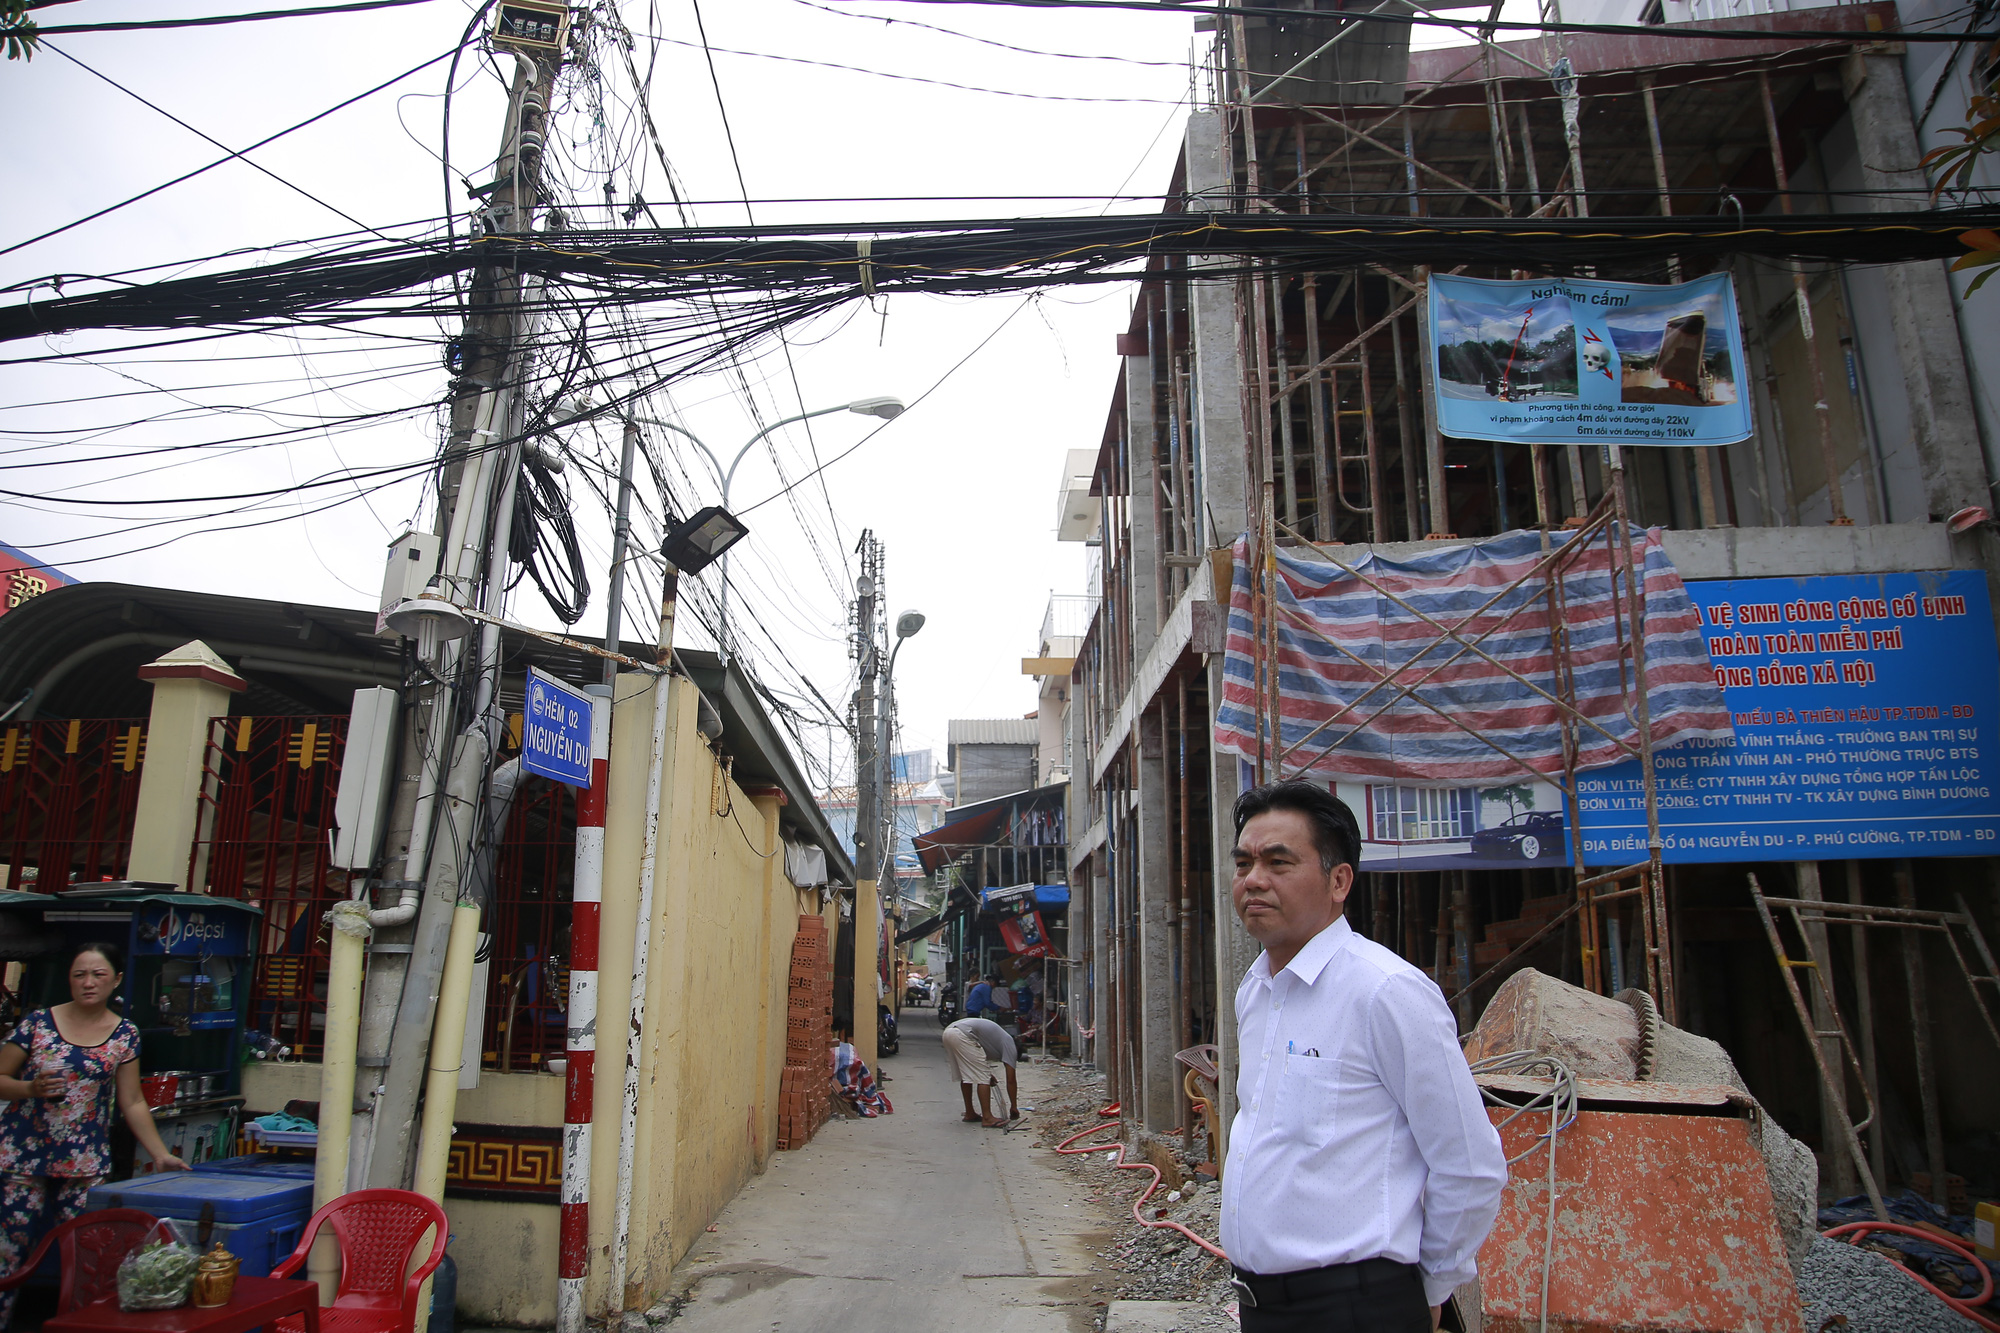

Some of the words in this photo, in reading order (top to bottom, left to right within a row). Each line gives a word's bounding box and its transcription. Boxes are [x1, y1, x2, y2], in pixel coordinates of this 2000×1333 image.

[1531, 286, 1586, 303] Nghiêm
[1591, 290, 1630, 307] cấm!
[1500, 416, 1522, 424] phạm
[1523, 415, 1554, 423] khoảng
[1577, 413, 1592, 422] 4m
[1595, 414, 1607, 423] đối
[1609, 415, 1621, 423] với
[1624, 415, 1650, 425] đường
[1651, 416, 1665, 426] dây
[1667, 415, 1690, 425] 22kV
[1529, 404, 1562, 412] Phương
[1564, 404, 1579, 412] tiện
[1593, 404, 1615, 413] công,
[1640, 405, 1655, 413] giới
[1577, 426, 1593, 435] 6m
[1595, 426, 1608, 435] đối
[1609, 427, 1622, 436] với
[1624, 428, 1650, 437] đường
[1651, 428, 1665, 438] dây
[1667, 428, 1695, 437] 110kV
[1708, 601, 1734, 630] VỆ
[1738, 603, 1781, 625] SINH
[1785, 598, 1834, 623] CÔNG
[1837, 596, 1889, 624] CỘNG
[1891, 591, 1917, 618] CỐ
[1922, 595, 1966, 621] ĐỊNH
[1709, 631, 1761, 657] HOÀN
[1764, 629, 1816, 654] TOÀN
[1818, 624, 1869, 653] MIỄN
[1872, 625, 1903, 651] PHÍ
[1714, 664, 1753, 692] ỘNG
[1757, 659, 1808, 687] ĐỒNG
[1812, 659, 1838, 685] XÃ
[1842, 659, 1876, 688] HỘI
[544, 694, 566, 724] HẺM
[568, 709, 579, 730] 02
[1735, 706, 1773, 726] MIẾU
[1776, 707, 1798, 724] BÀ
[1799, 707, 1846, 724] THIÊN
[1848, 705, 1881, 725] HẬU
[1883, 706, 1939, 721] TP.TDM
[1952, 704, 1975, 719] BD
[528, 722, 573, 763] NGUYỄN
[575, 741, 589, 768] DU
[1740, 734, 1773, 747] VĨNH
[1776, 729, 1825, 746] THẮNG
[1836, 728, 1895, 744] TRƯỞNG
[1898, 730, 1928, 743] BAN
[1931, 729, 1955, 743] TRỊ
[1958, 727, 1978, 741] SỰ
[1655, 755, 1687, 769] ÔNG
[1690, 751, 1731, 768] TRẦN
[1734, 752, 1769, 766] VĨNH
[1773, 753, 1793, 765] AN
[1805, 750, 1837, 764] PHÓ
[1839, 748, 1902, 763] THƯỜNG
[1904, 748, 1946, 763] TRỰC
[1949, 748, 1980, 760] BTS
[1577, 780, 1607, 792] ĐƠN
[1610, 780, 1624, 793] VỊ
[1626, 774, 1666, 790] THẾT
[1670, 773, 1693, 789] KẾ:
[1697, 776, 1724, 788] CTY
[1728, 775, 1766, 787] TNHH
[1770, 772, 1797, 786] XÂY
[1801, 773, 1841, 787] DỰNG
[1843, 767, 1884, 783] TỔNG
[1887, 770, 1915, 784] HỢP
[1919, 766, 1948, 781] TẤN
[1951, 767, 1980, 782] LỘC
[1579, 798, 1608, 810] ĐƠN
[1612, 798, 1626, 811] VỊ
[1656, 793, 1699, 808] CÔNG:
[1702, 794, 1729, 806] CTY
[1733, 793, 1771, 805] TNHH
[1774, 792, 1792, 804] TV
[1804, 791, 1824, 803] TK
[1827, 788, 1855, 802] XÂY
[1858, 789, 1899, 803] DỰNG
[1902, 786, 1936, 800] BÌNH
[1939, 786, 1990, 799] DƯƠNG
[1583, 839, 1608, 853] ĐỊA
[1660, 833, 1676, 849] SỐ
[1679, 838, 1696, 849] 04
[1699, 831, 1759, 848] NGUYỄN
[1763, 835, 1784, 847] DU
[1796, 834, 1811, 846] P.
[1814, 830, 1844, 845] PHÚ
[1848, 829, 1905, 845] CƯỜNG,
[1907, 830, 1962, 842] TP.TDM
[1974, 828, 1996, 841] BD
[183, 922, 225, 942] pepsi
